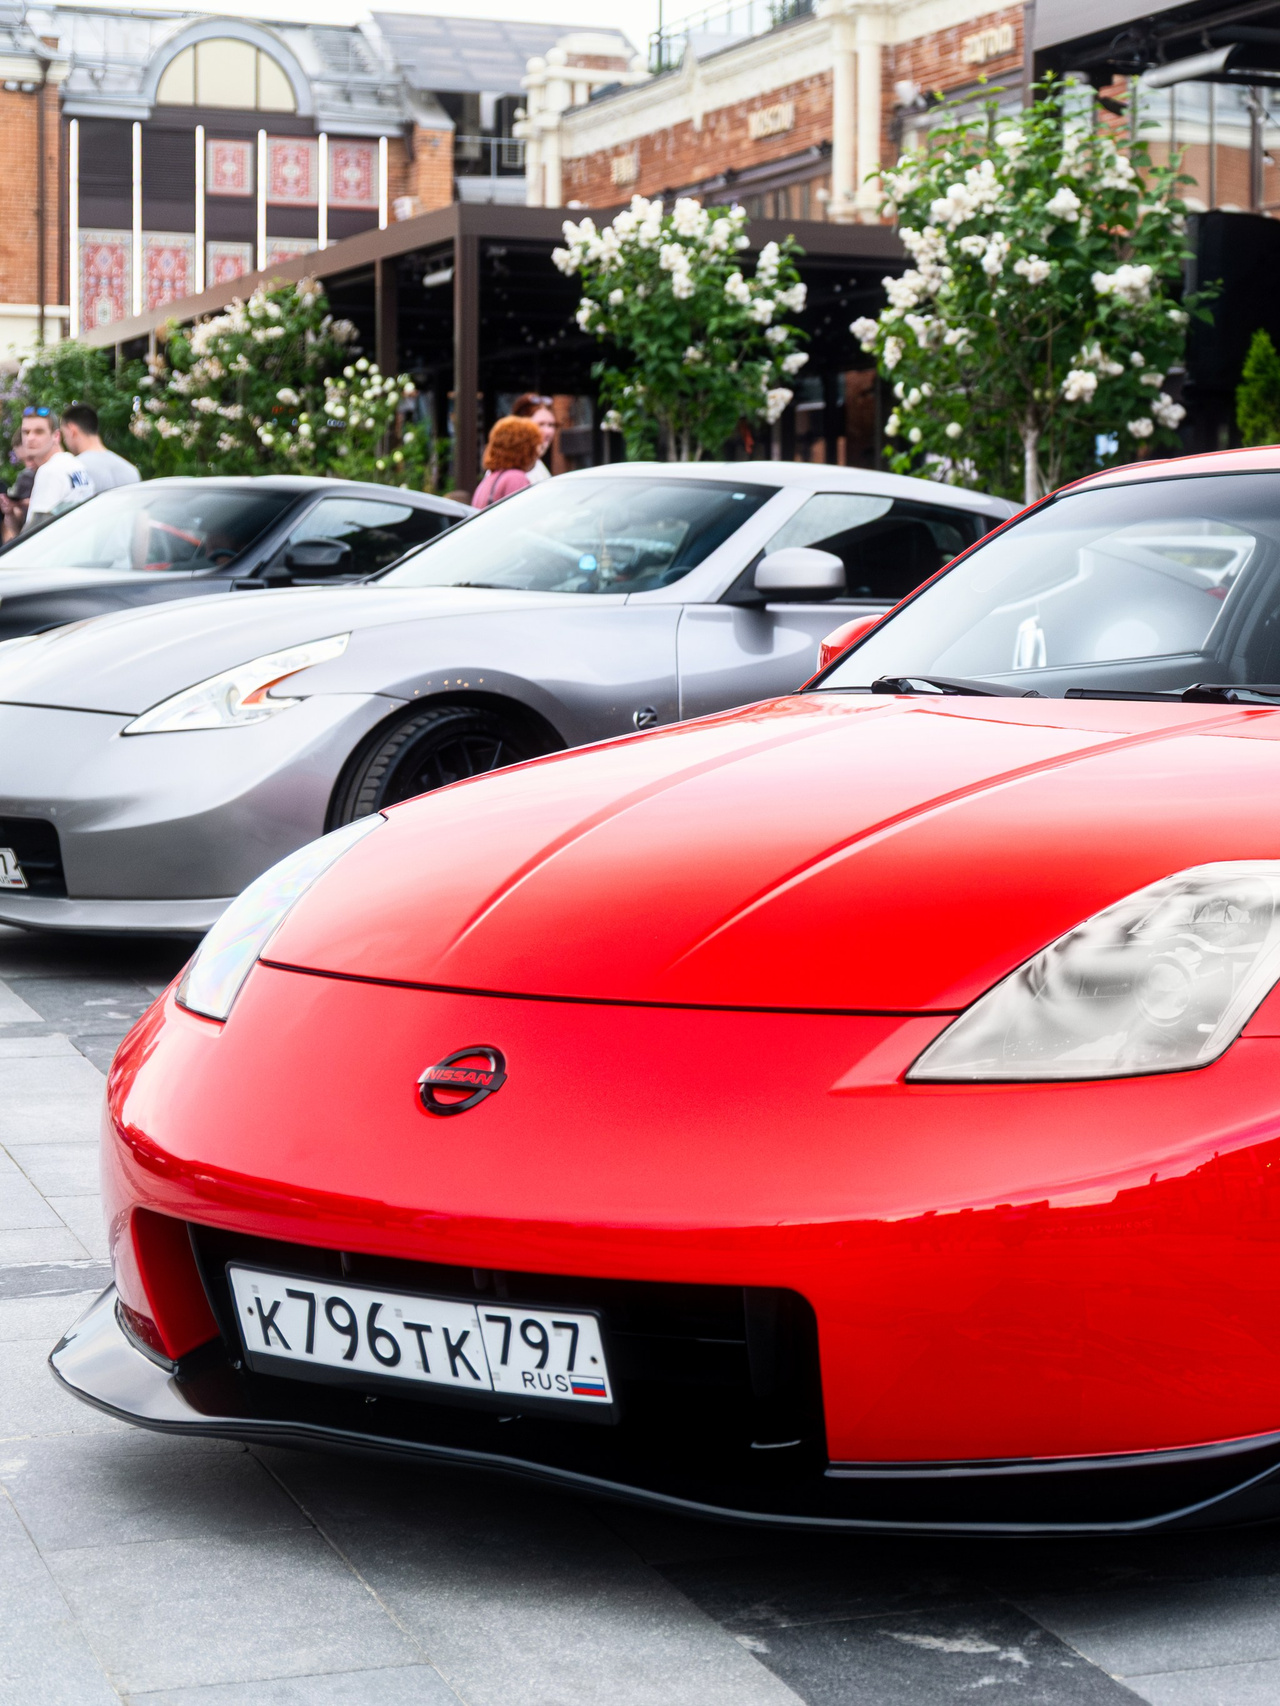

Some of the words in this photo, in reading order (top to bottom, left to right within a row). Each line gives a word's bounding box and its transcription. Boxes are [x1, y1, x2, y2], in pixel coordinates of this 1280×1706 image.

[425, 1069, 494, 1086] NISSAN
[485, 1314, 579, 1372] 797
[522, 1371, 569, 1393] RUS
